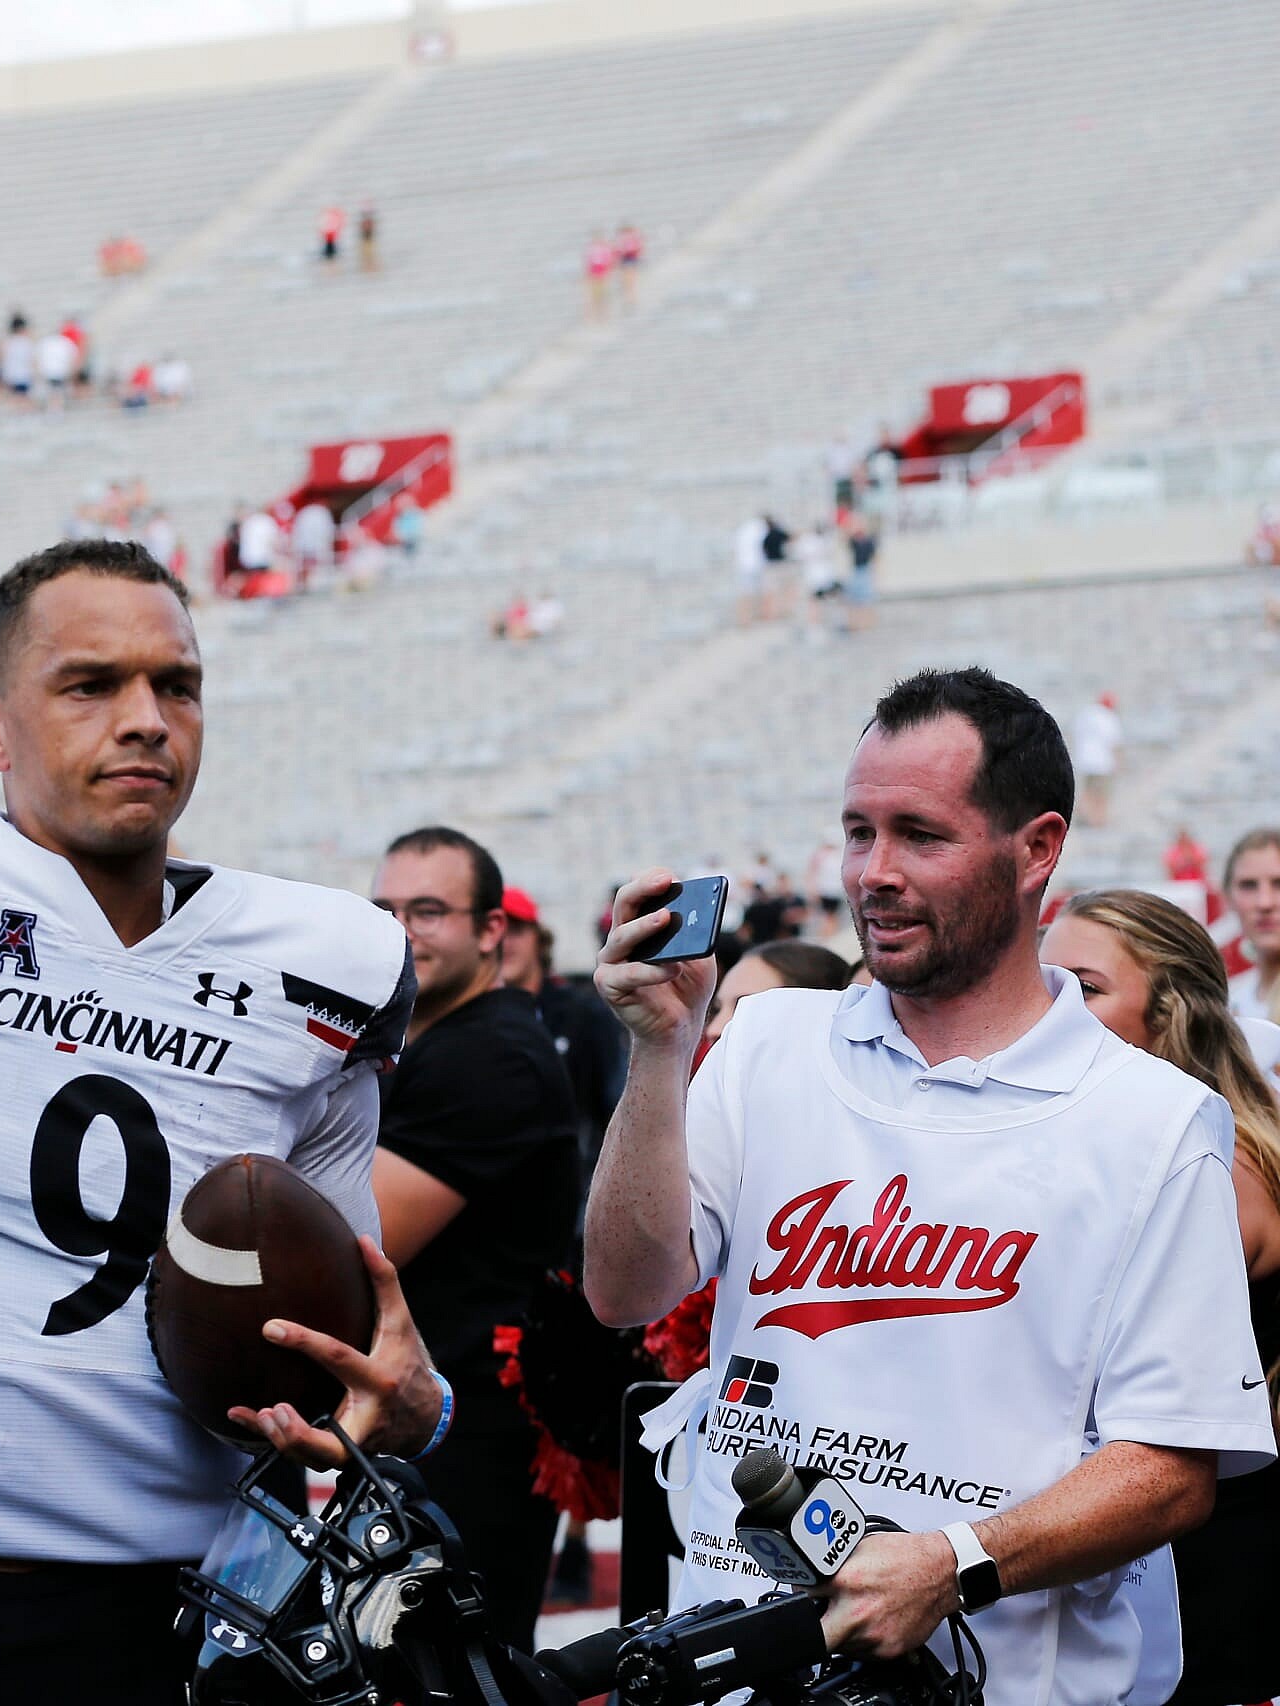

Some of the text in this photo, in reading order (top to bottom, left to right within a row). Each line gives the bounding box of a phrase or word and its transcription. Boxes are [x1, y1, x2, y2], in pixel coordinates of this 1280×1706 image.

[30, 1074, 172, 1337] 9
[748, 1173, 1039, 1297] Indiana
[712, 1405, 909, 1464] INDIANA FARM
[691, 1530, 723, 1550] OFFICIAL
[804, 1499, 836, 1546] 9
[823, 1520, 859, 1567] WCPO
[691, 1551, 706, 1567] THIS
[709, 1557, 739, 1573] VEST
[629, 1675, 650, 1690] JVC
